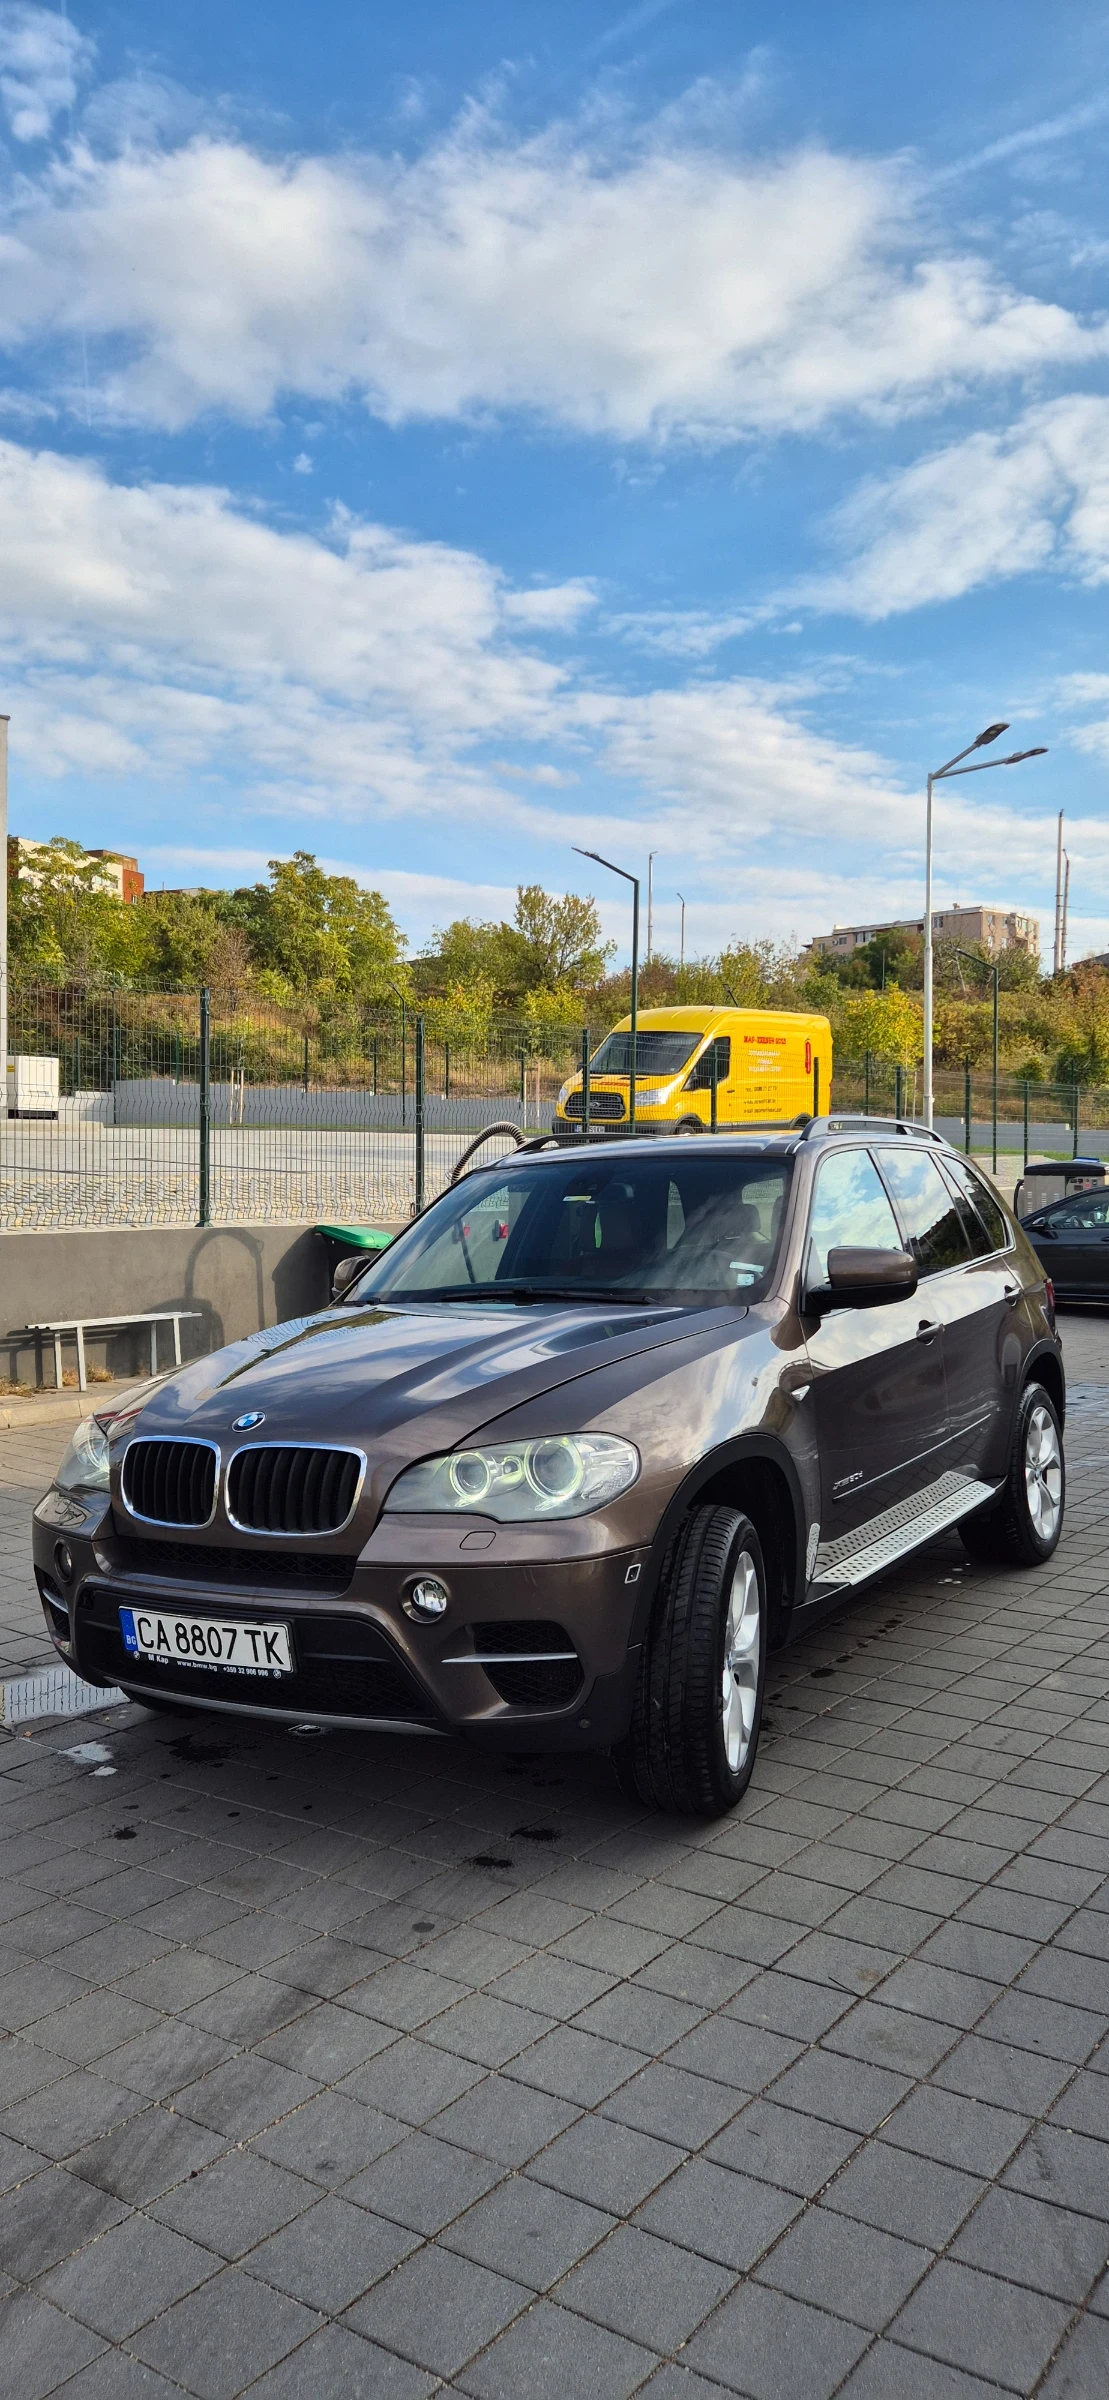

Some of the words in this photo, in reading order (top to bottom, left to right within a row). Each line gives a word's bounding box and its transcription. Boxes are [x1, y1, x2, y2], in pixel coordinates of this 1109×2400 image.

[126, 1635, 137, 1645] BG
[138, 1617, 171, 1651] CA
[175, 1622, 237, 1660] 8807
[244, 1630, 284, 1665] TK
[177, 1660, 218, 1672] www.bmw.bg
